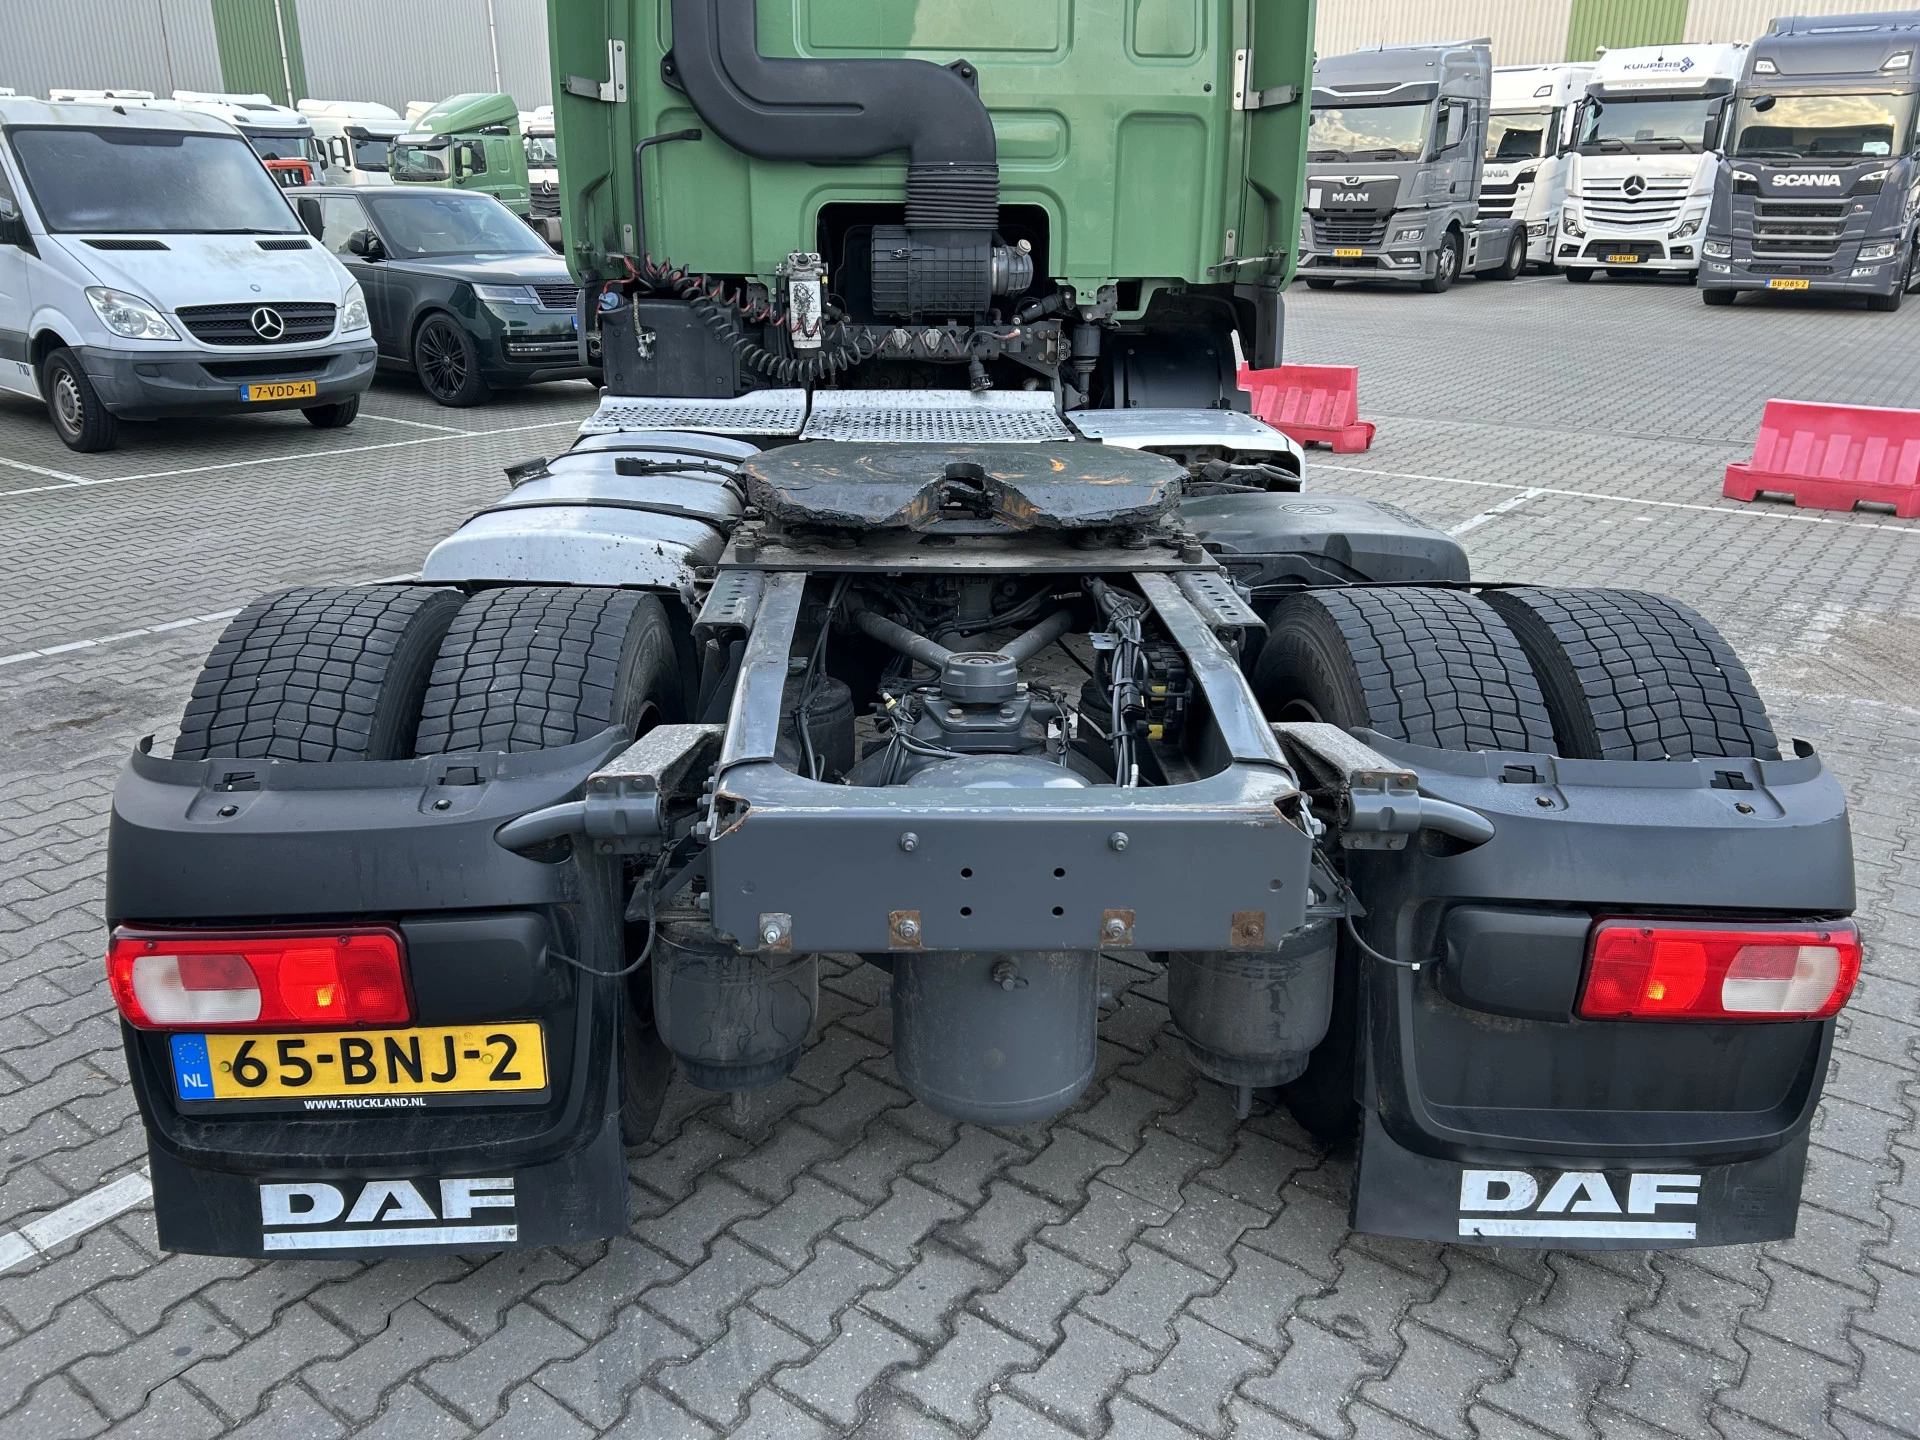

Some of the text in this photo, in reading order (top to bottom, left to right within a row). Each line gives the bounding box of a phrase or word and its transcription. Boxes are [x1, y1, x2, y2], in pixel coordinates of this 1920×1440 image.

[1623, 62, 1681, 70] KUIJPERS
[1772, 174, 1841, 187] SCANIA
[1332, 192, 1370, 202] MAN
[255, 383, 312, 399] 7-VDD-41
[183, 1073, 209, 1088] NL
[231, 1033, 522, 1088] 65-BNJ-2
[303, 1097, 427, 1110] WWW.TRUCKLAND.NL
[1458, 1169, 1702, 1214] DAF
[259, 1177, 516, 1226] DAF
